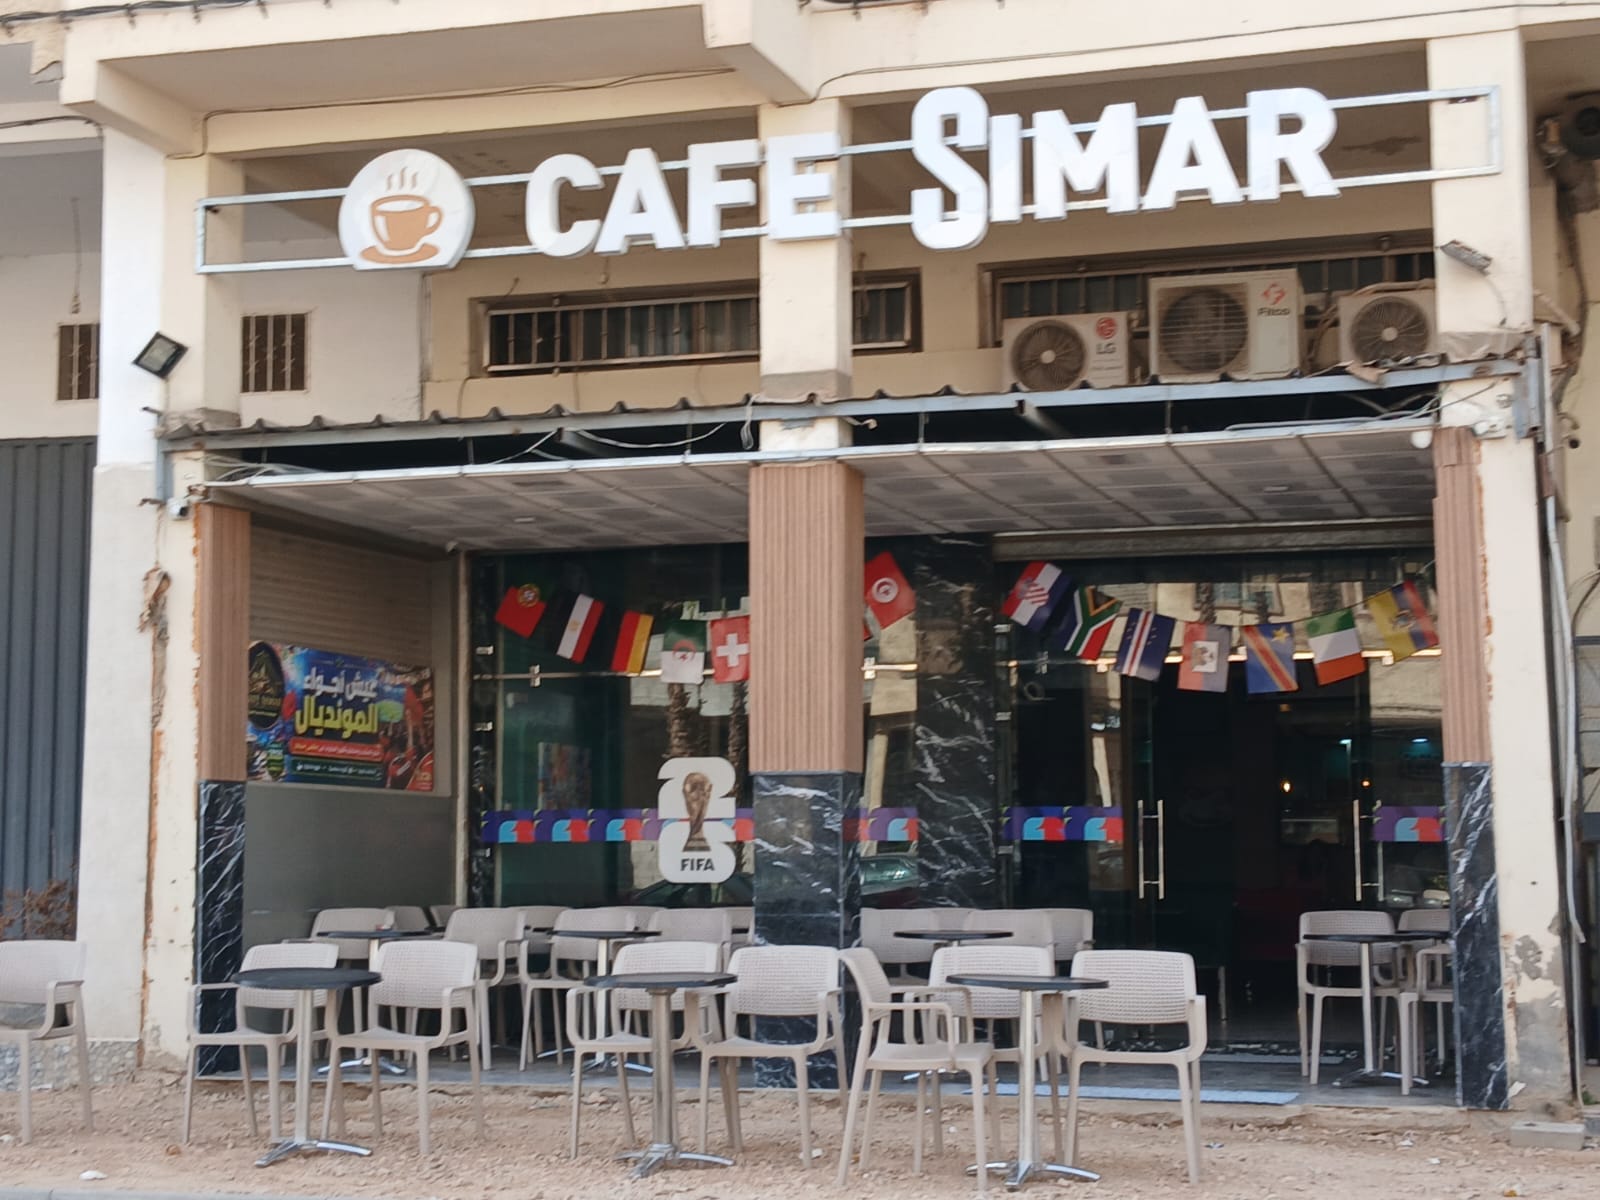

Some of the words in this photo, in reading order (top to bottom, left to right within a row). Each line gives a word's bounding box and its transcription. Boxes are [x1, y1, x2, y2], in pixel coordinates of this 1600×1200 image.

[525, 133, 841, 258] CAFE
[911, 86, 1341, 250] SIMAR
[1095, 342, 1117, 355] LG
[294, 694, 378, 739] المونديال
[680, 858, 715, 871] FIFA
